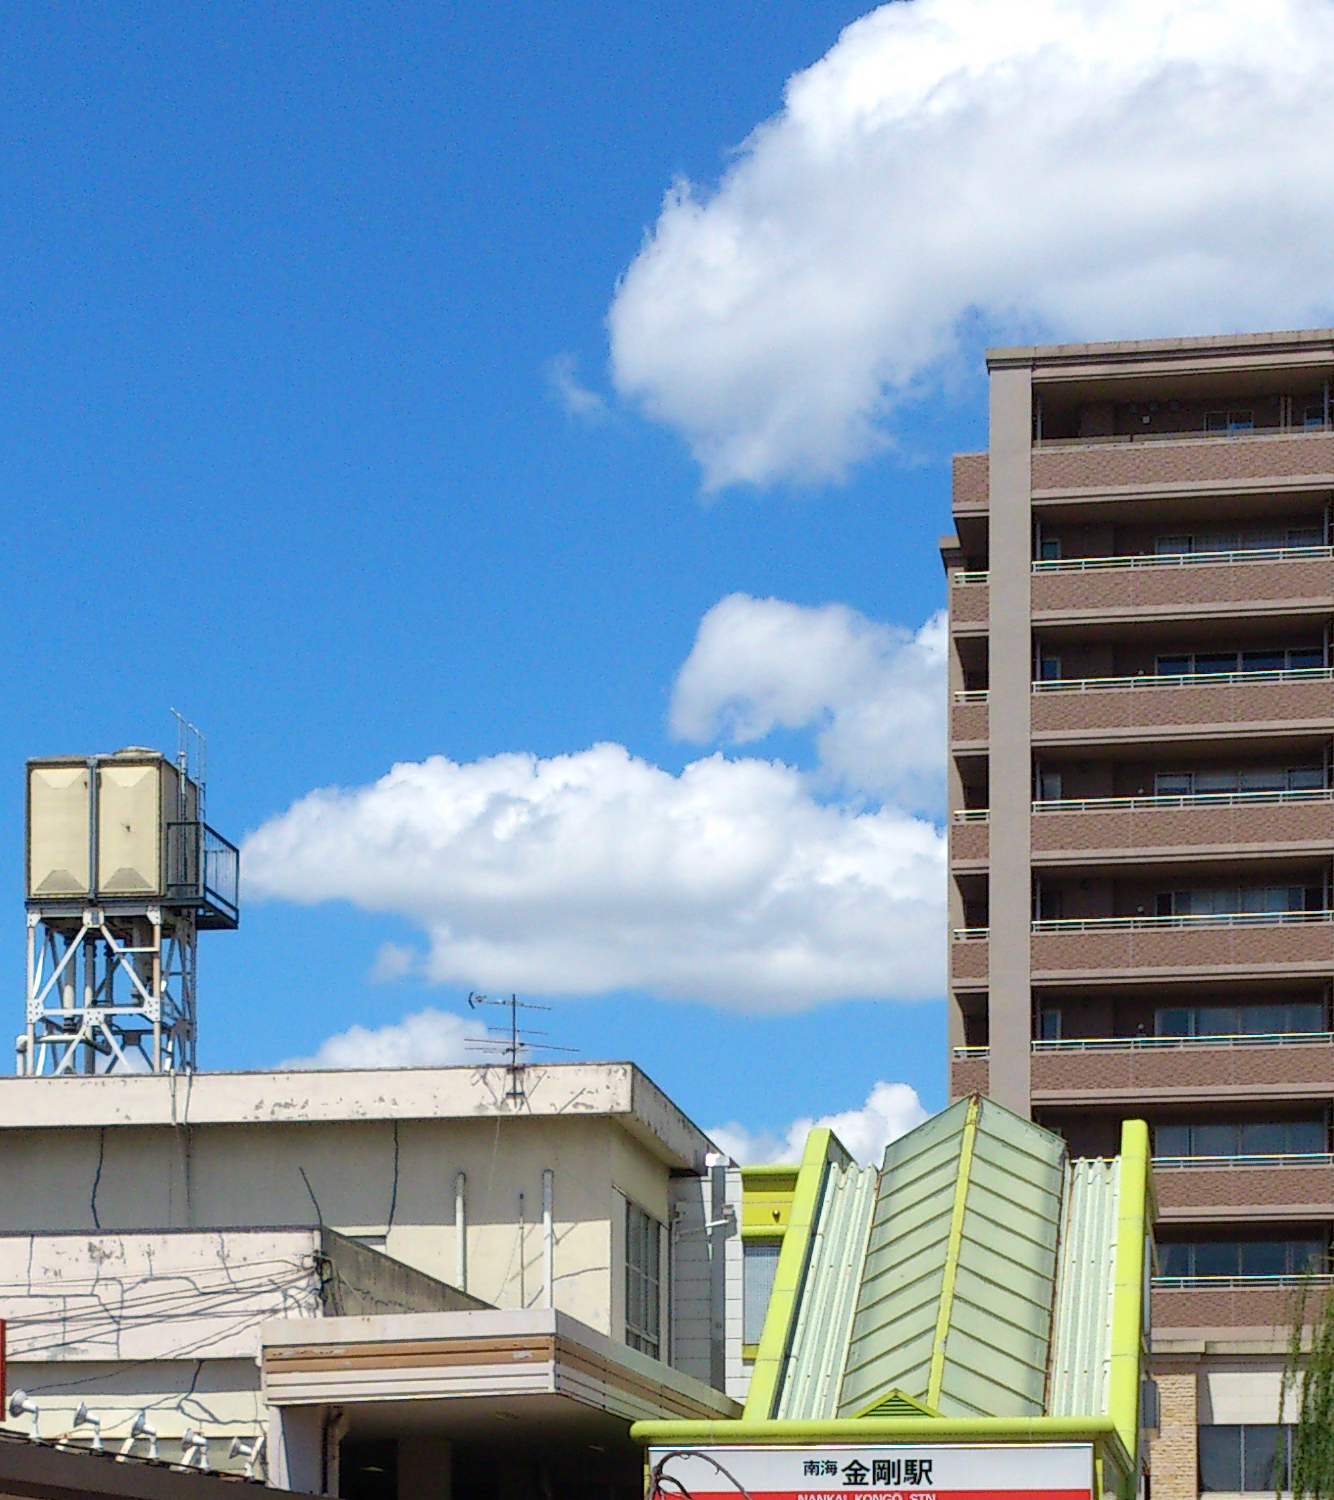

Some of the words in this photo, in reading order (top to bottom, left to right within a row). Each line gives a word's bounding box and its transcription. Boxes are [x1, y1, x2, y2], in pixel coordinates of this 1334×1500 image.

[802, 1459, 838, 1477] 南海
[841, 1459, 933, 1487] 金剛駅
